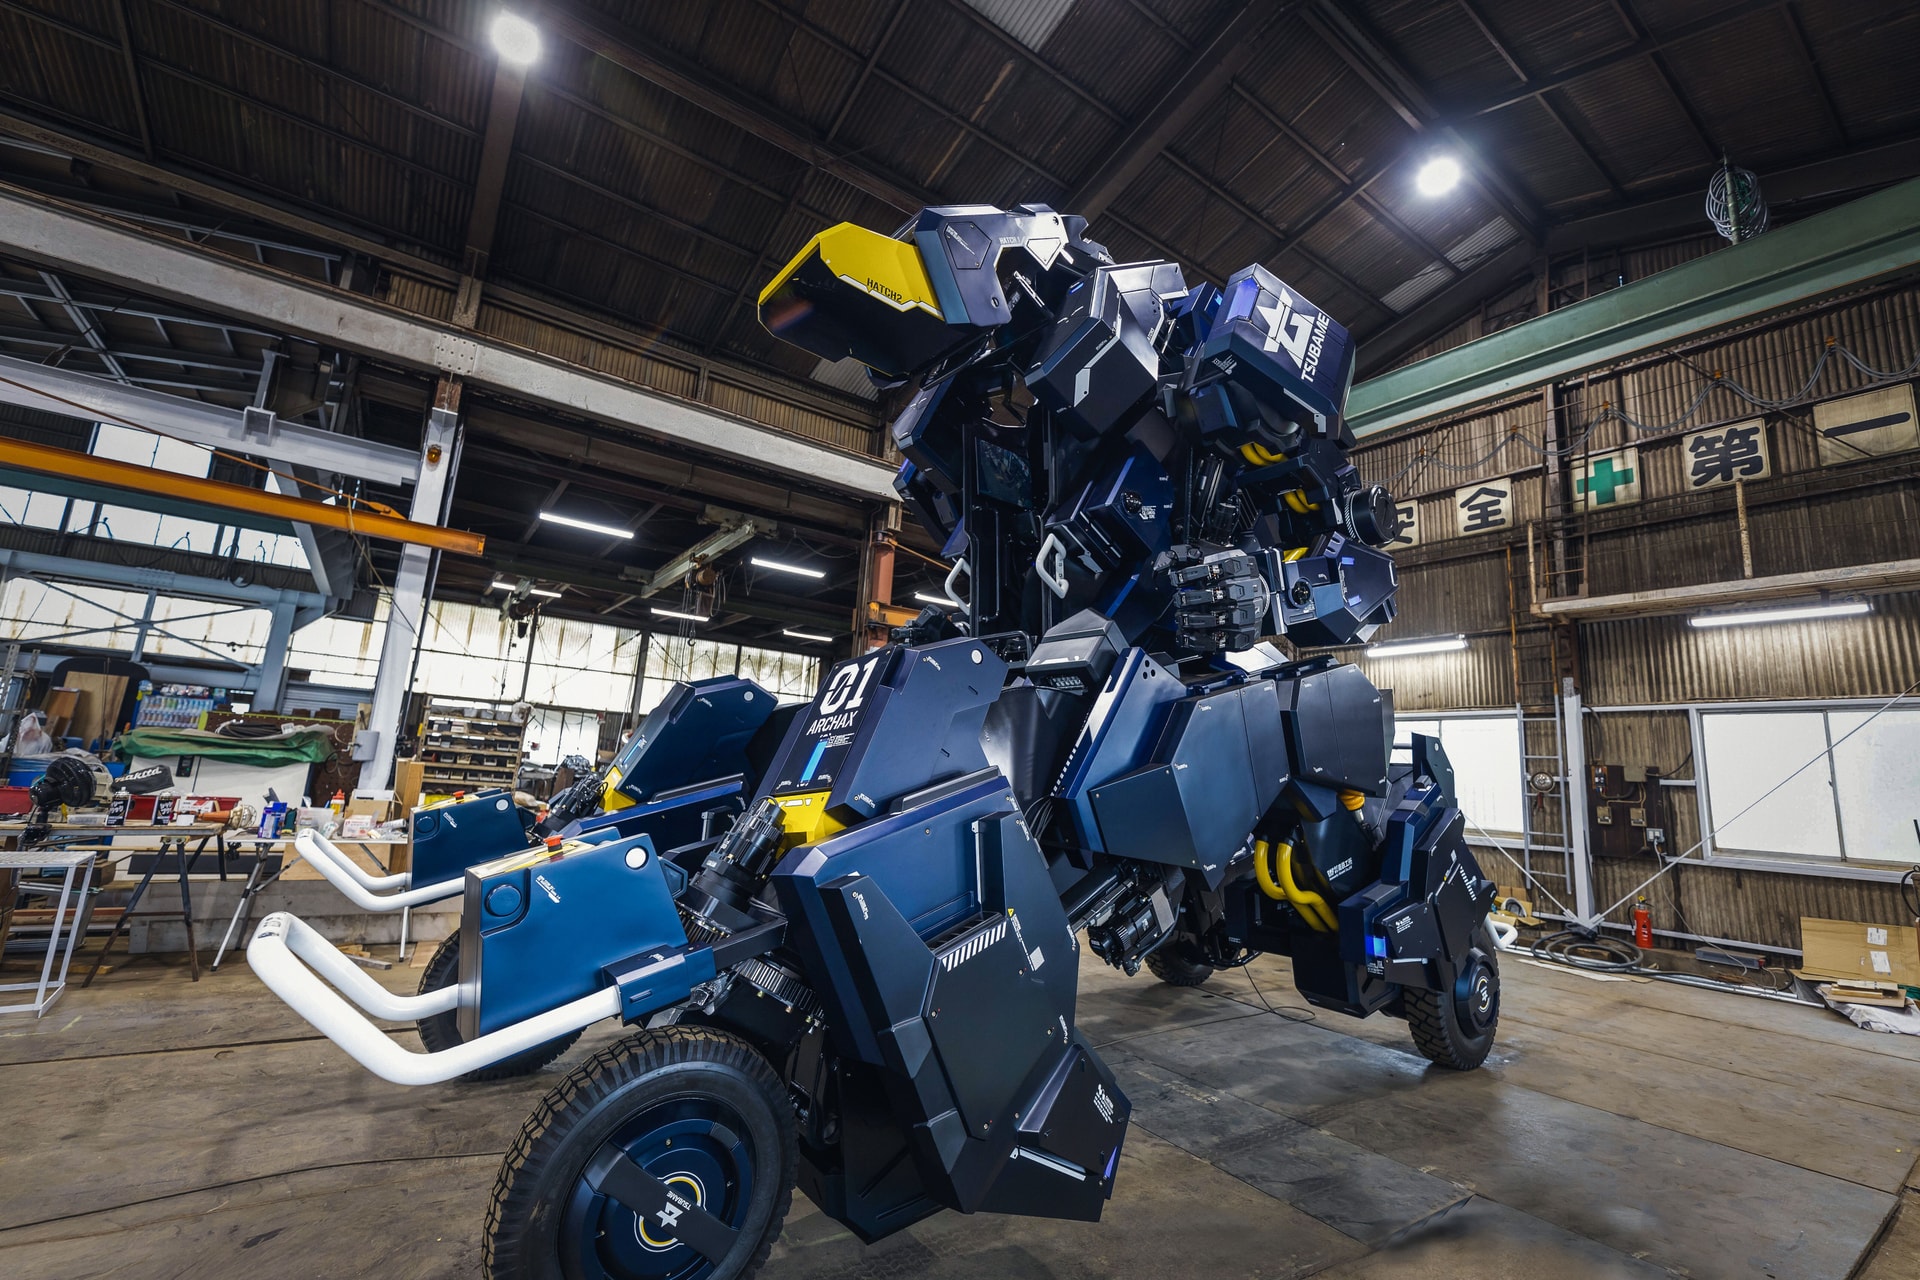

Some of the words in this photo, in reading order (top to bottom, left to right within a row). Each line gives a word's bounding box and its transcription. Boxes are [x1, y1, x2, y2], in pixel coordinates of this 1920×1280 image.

[1301, 312, 1330, 383] TSUBAME
[819, 656, 880, 716] 01
[806, 711, 858, 736] ARCHAX
[666, 1190, 692, 1211] TSUBAME
